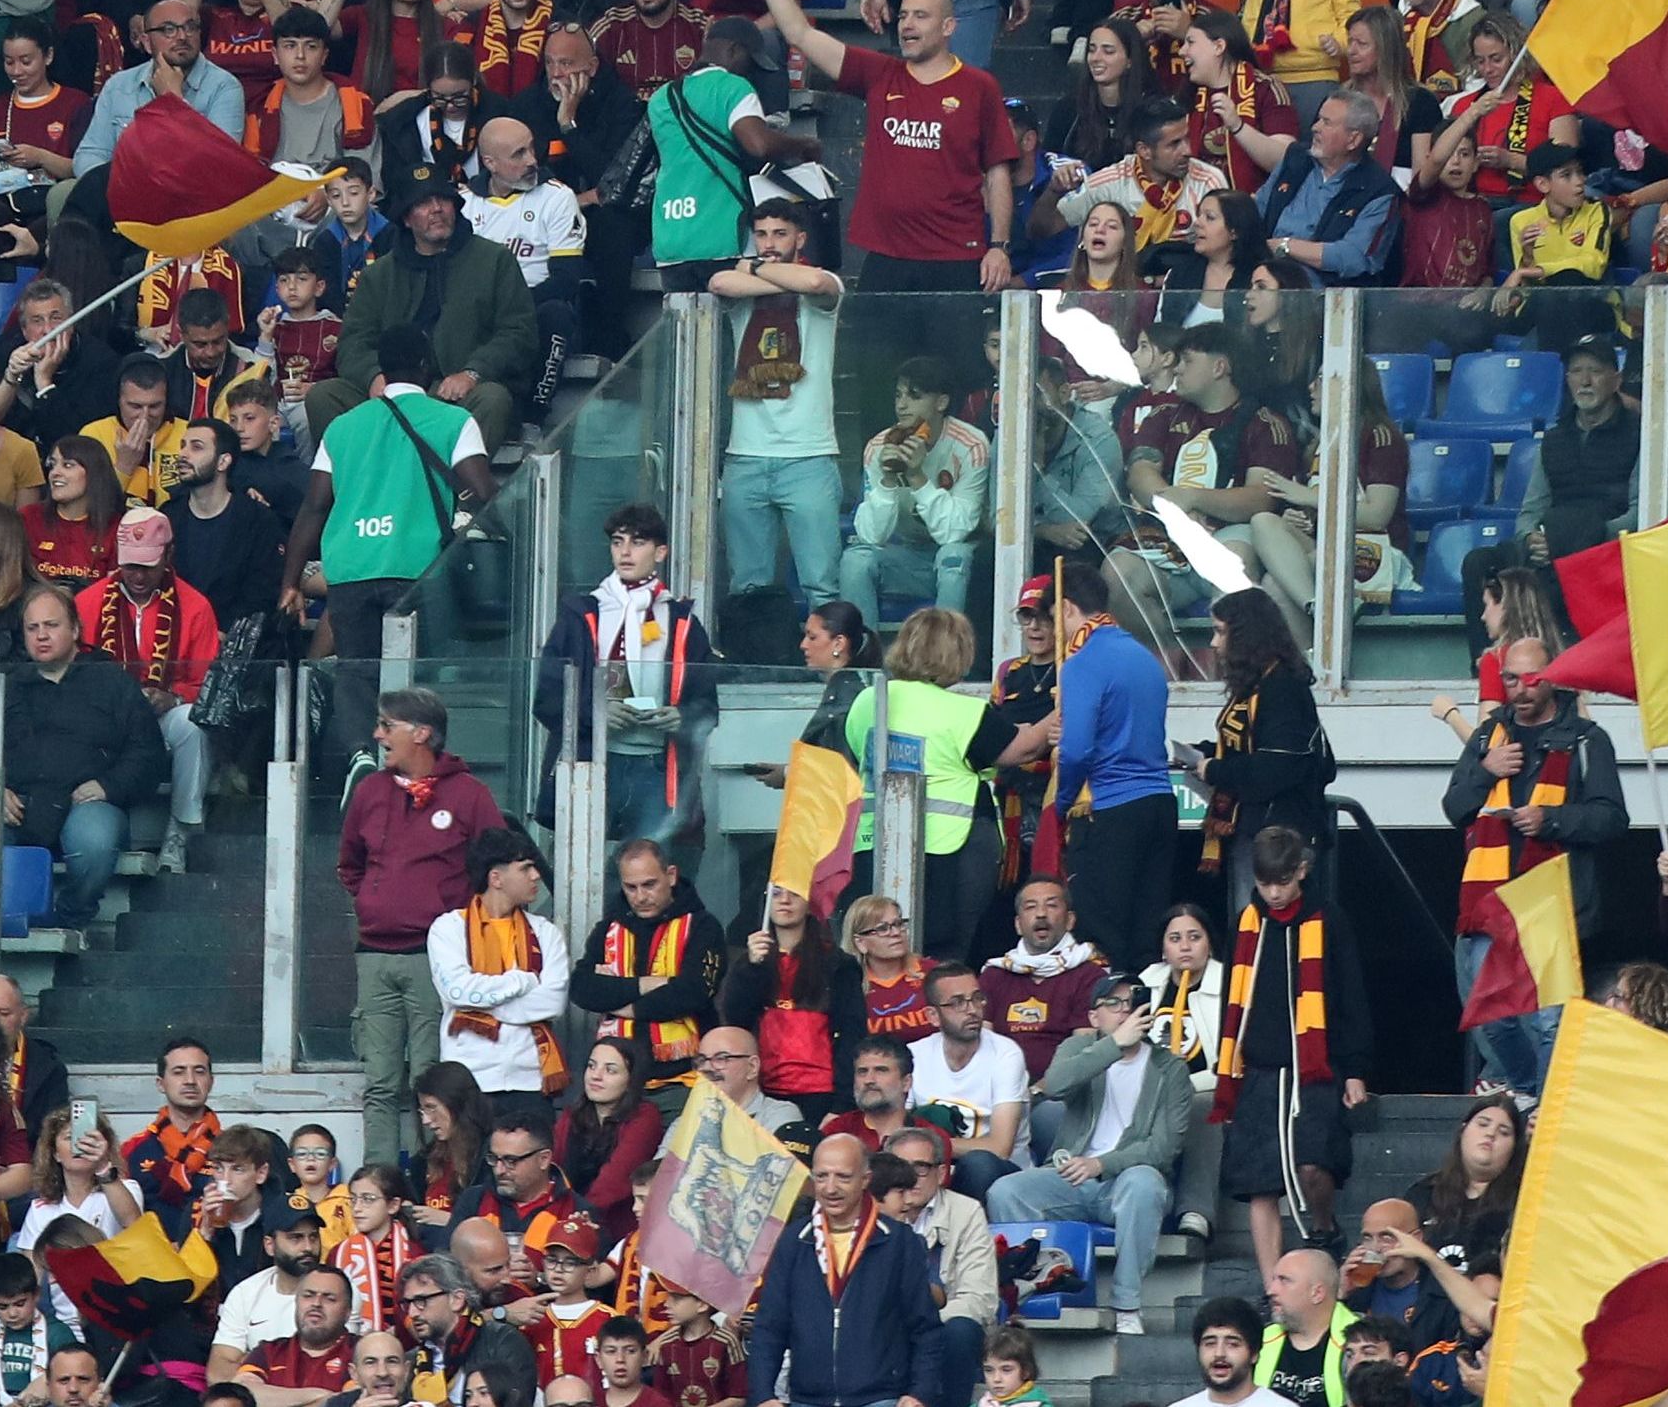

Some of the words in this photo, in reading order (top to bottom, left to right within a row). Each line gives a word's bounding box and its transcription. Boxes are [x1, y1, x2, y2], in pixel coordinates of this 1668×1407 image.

[883, 117, 942, 139] QATAR
[892, 134, 941, 150] AIRWAYS
[662, 195, 696, 221] 108
[506, 237, 534, 257] illa
[354, 515, 393, 538] 105
[37, 563, 100, 579] digitalbits
